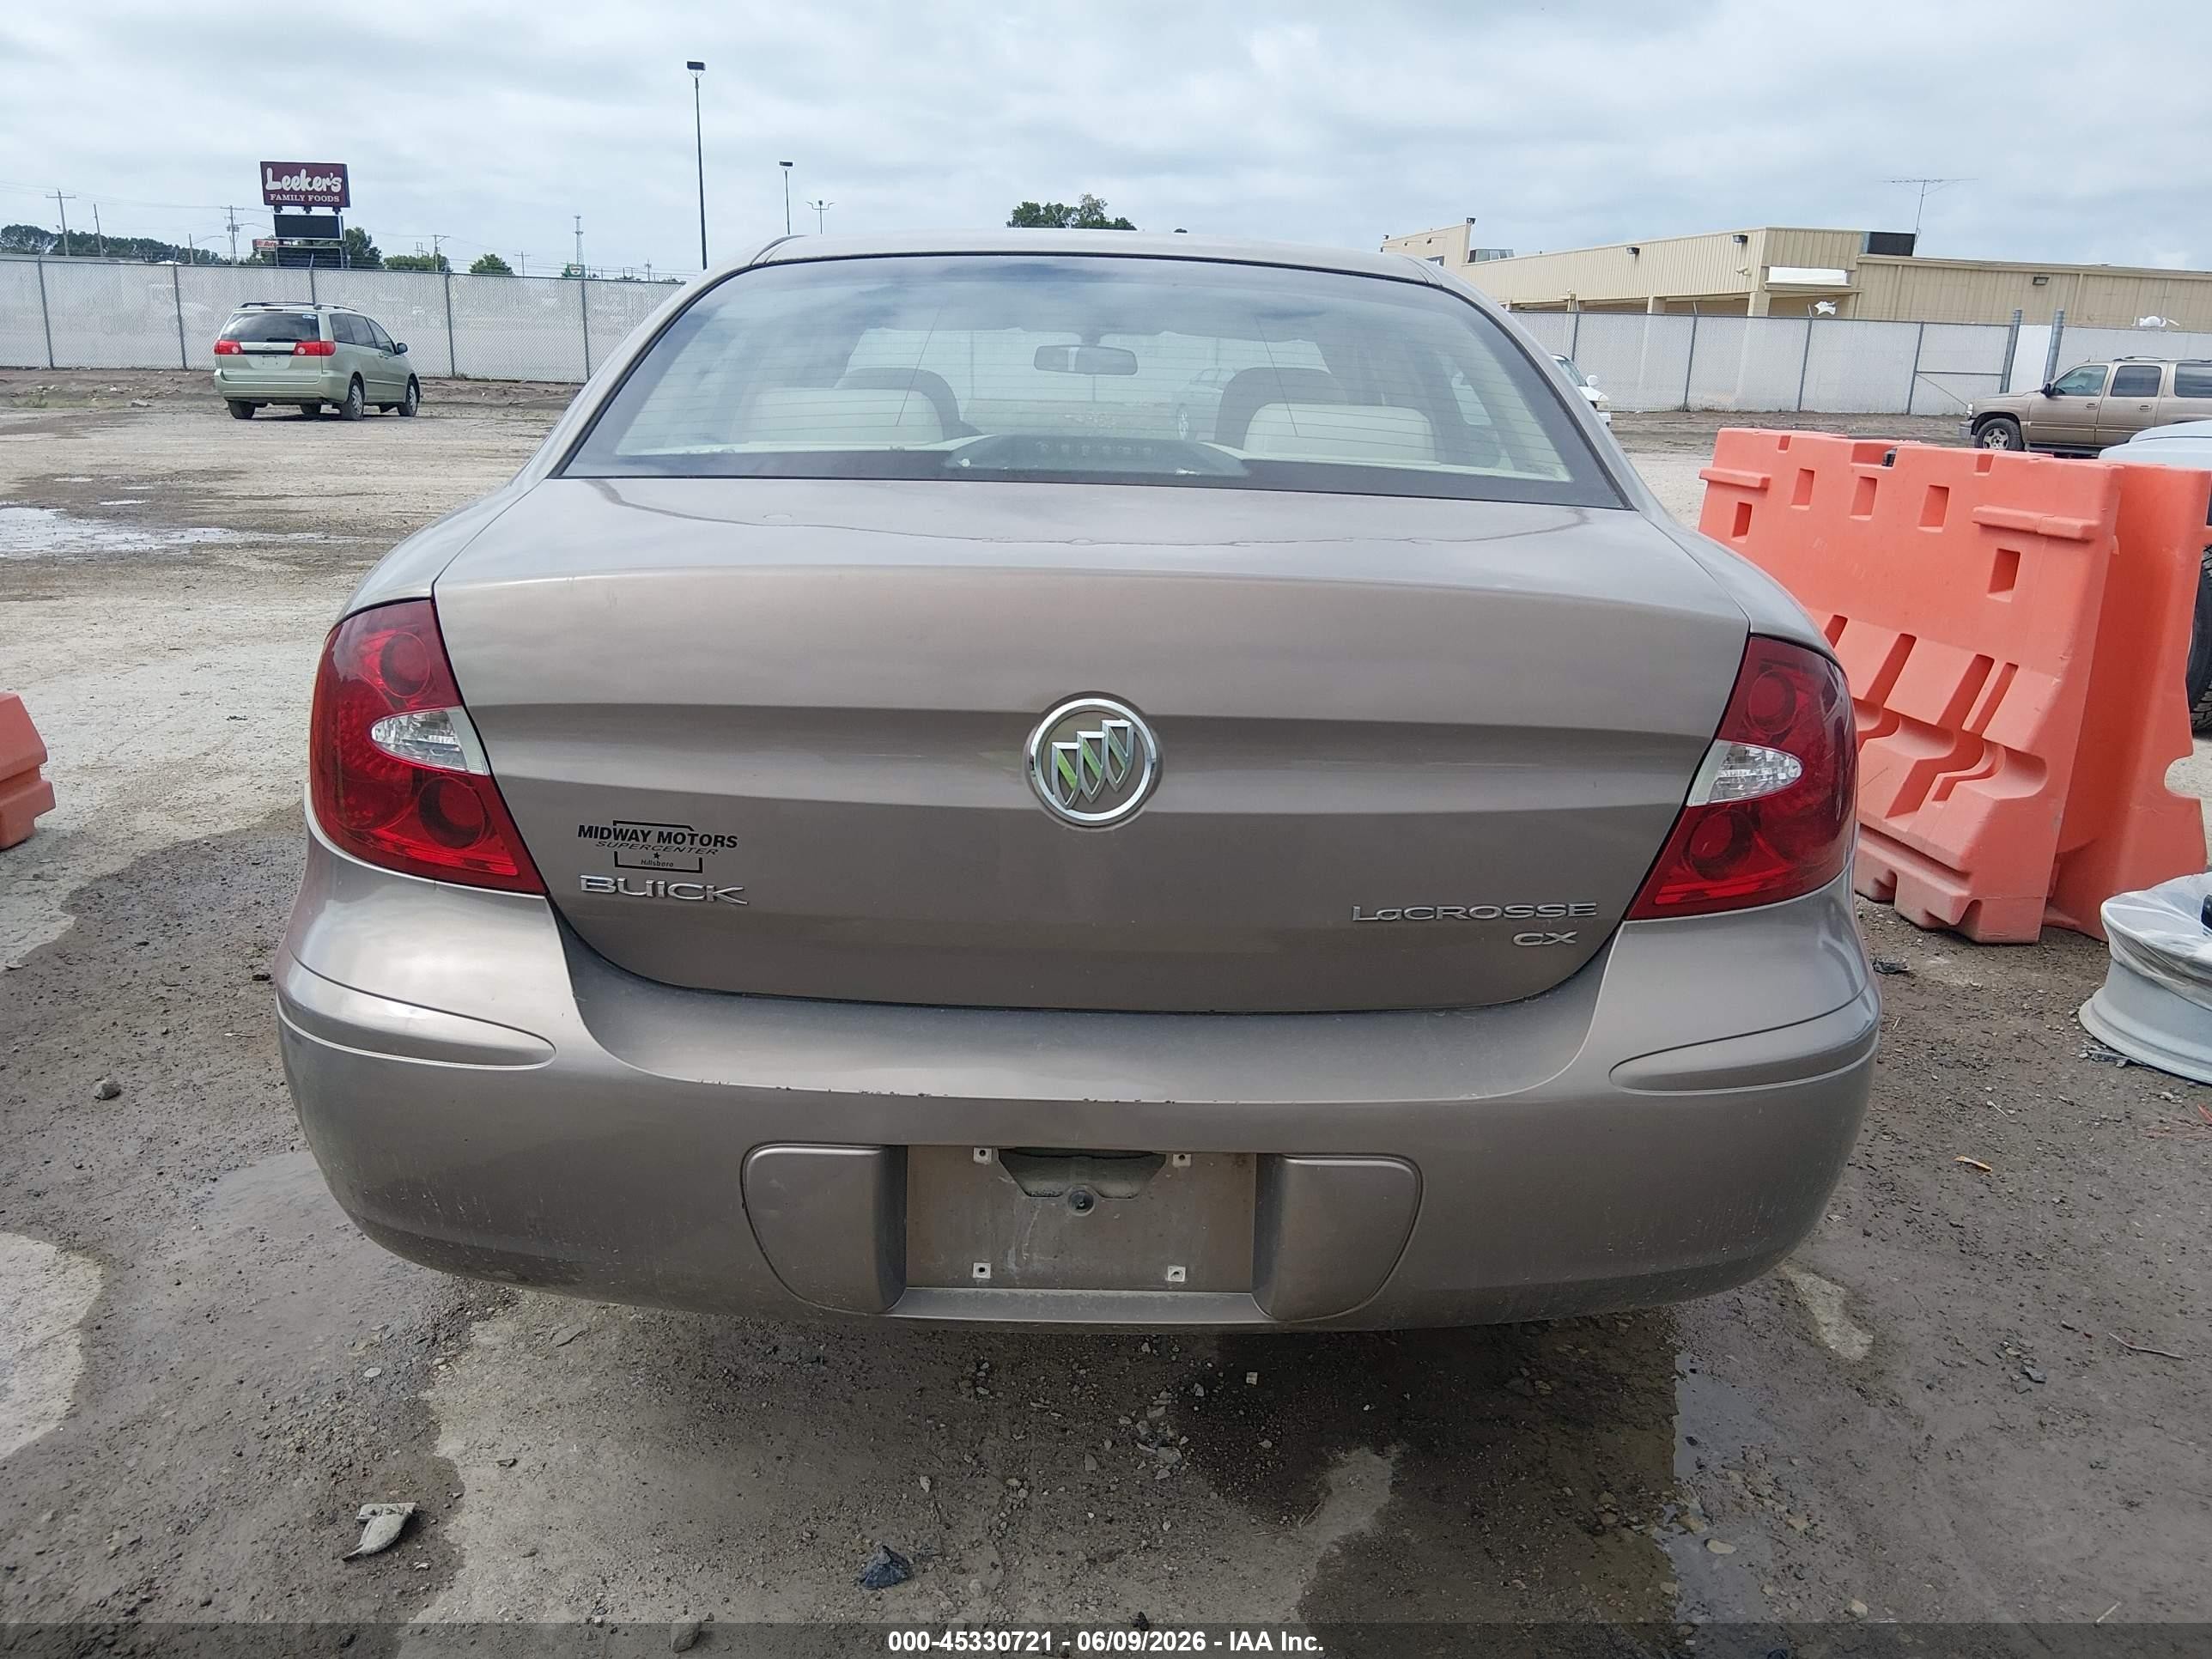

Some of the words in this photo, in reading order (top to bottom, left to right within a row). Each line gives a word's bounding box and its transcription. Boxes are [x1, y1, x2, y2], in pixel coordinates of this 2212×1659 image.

[265, 167, 343, 193] Leeker's
[308, 194, 340, 203] FOODS
[577, 824, 653, 843] MIDWAY
[656, 830, 738, 848] MOTORS
[595, 840, 720, 855] SUPERCENTER
[641, 859, 674, 867] Hillsboro
[579, 874, 749, 905] BUICK
[1352, 902, 1597, 921] LaCROSSE
[1512, 931, 1577, 946] CX
